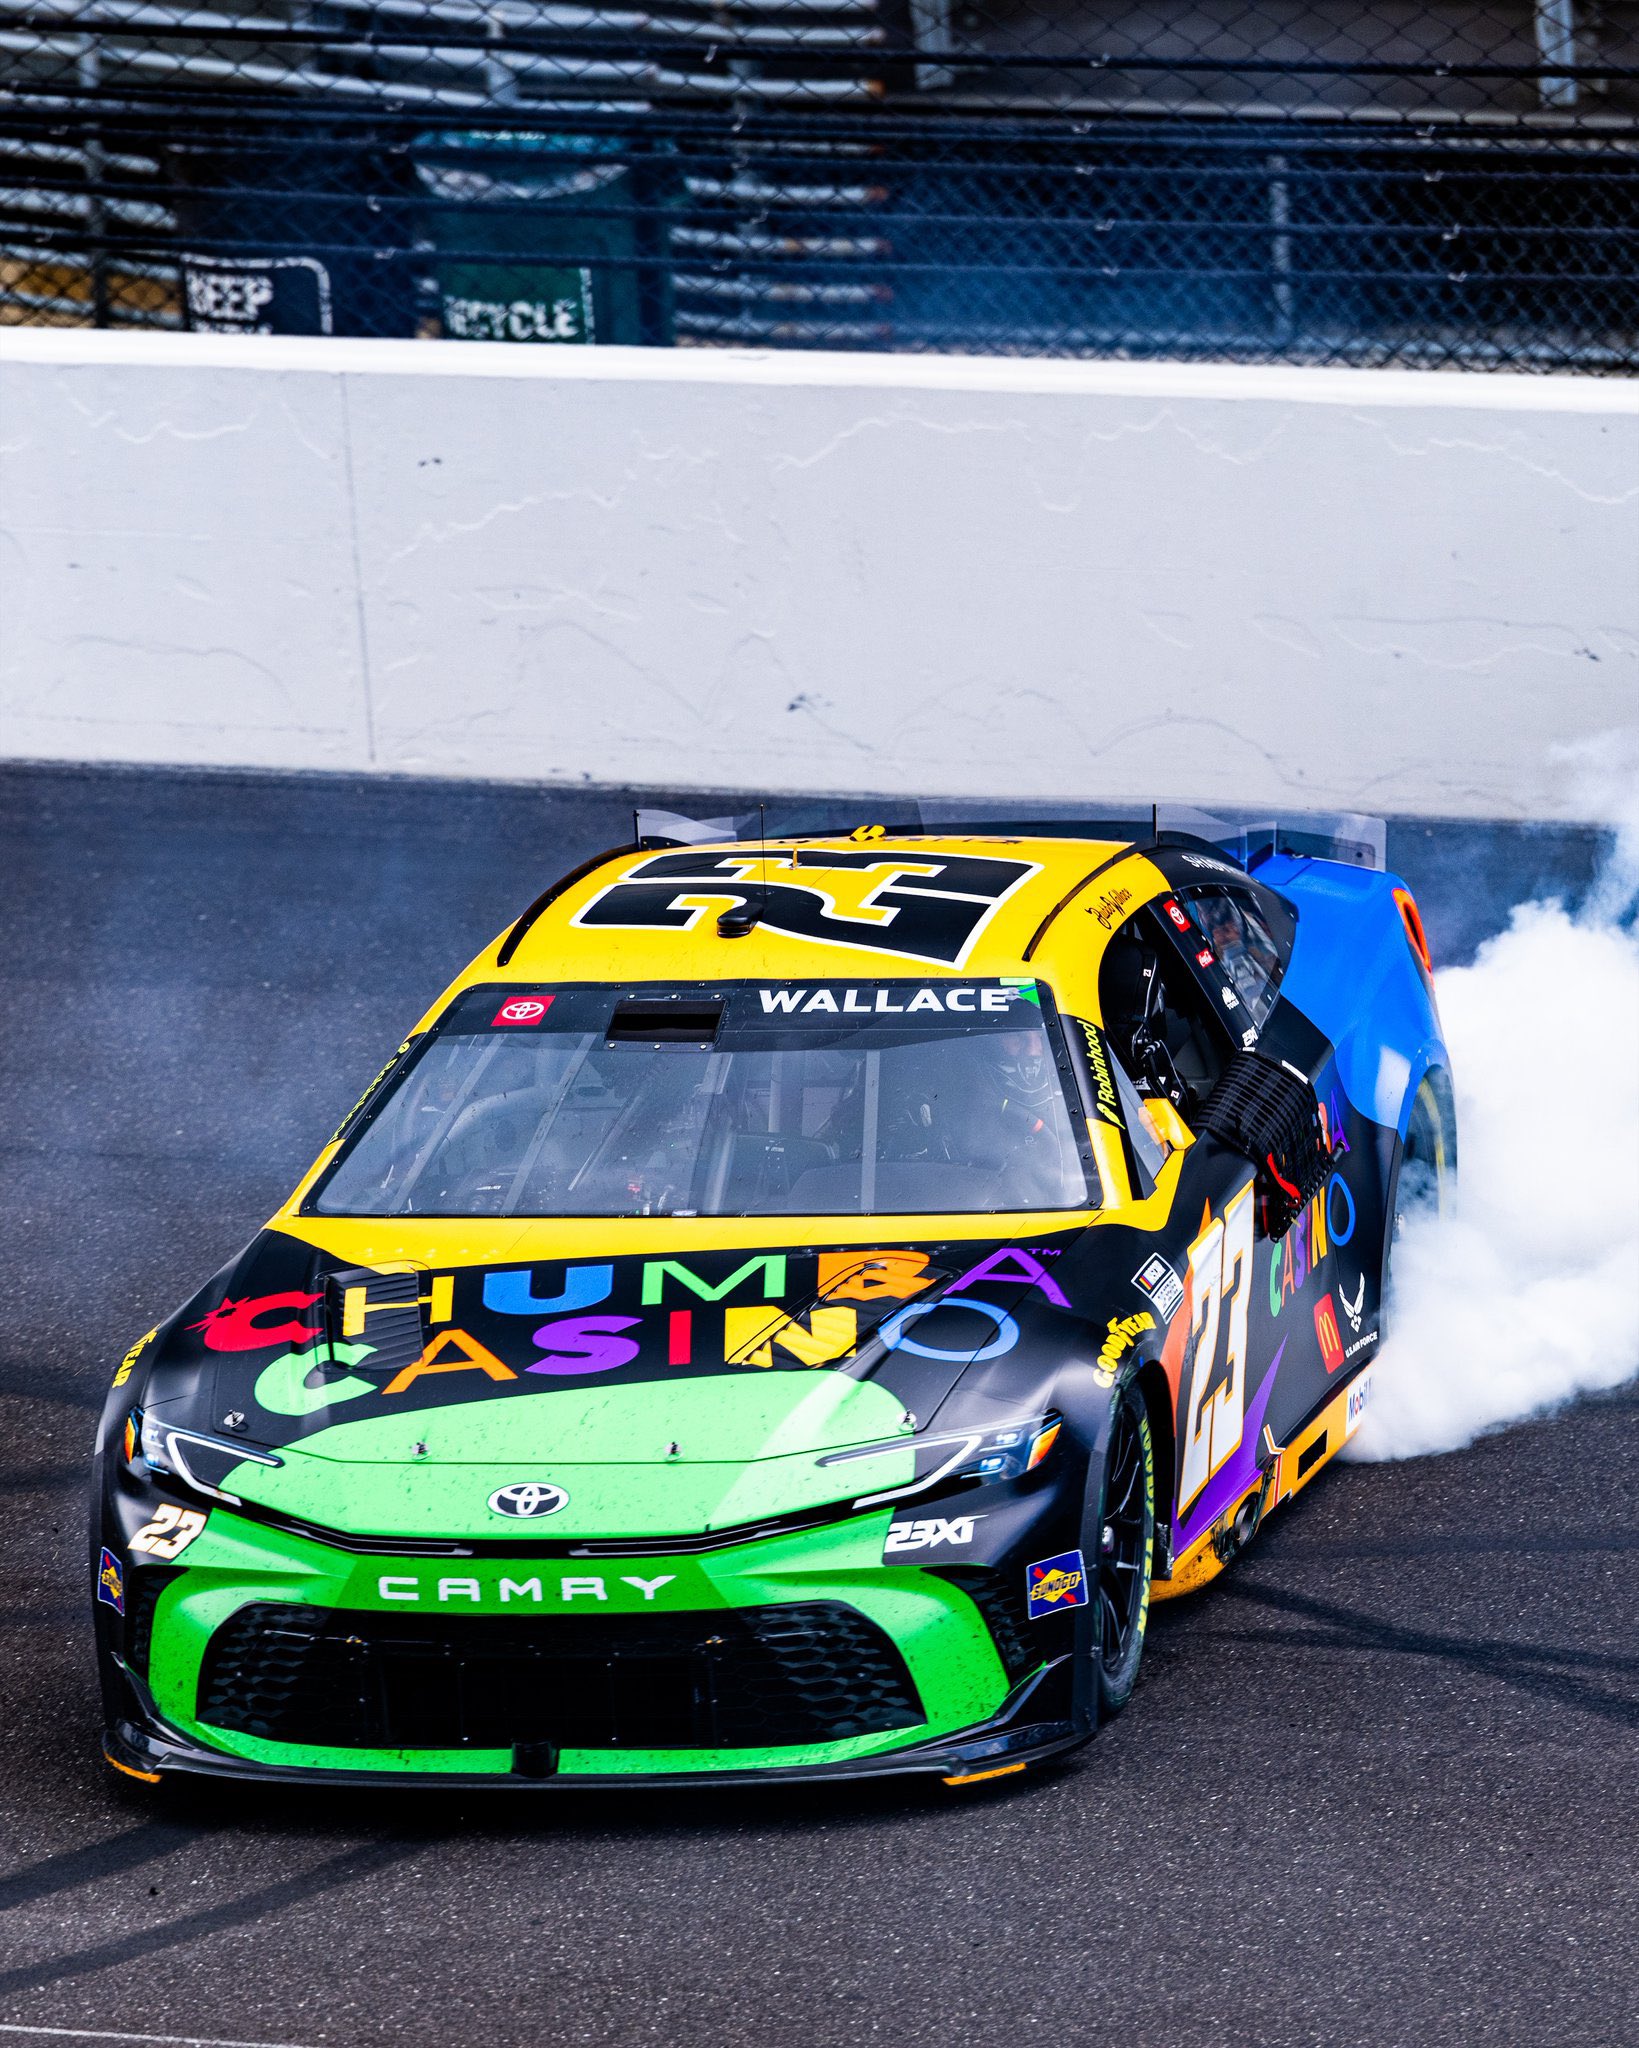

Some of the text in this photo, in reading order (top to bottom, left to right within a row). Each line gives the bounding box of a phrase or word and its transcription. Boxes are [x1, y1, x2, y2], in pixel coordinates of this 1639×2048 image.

[443, 296, 579, 340] ECYCLE
[759, 988, 1010, 1012] WALLACE
[1077, 1019, 1117, 1106] Robinhood
[1269, 1172, 1356, 1317] CASINO
[184, 1248, 1072, 1352] CHUMBA
[254, 1299, 1020, 1416] CASINO
[1093, 1311, 1157, 1389] GOODYEAR
[1177, 1179, 1255, 1520] 23
[1360, 1331, 1378, 1347] FORCE
[127, 1503, 207, 1559] 23
[378, 1575, 677, 1602] CAMRY
[1033, 1573, 1078, 1599] SUNOCO
